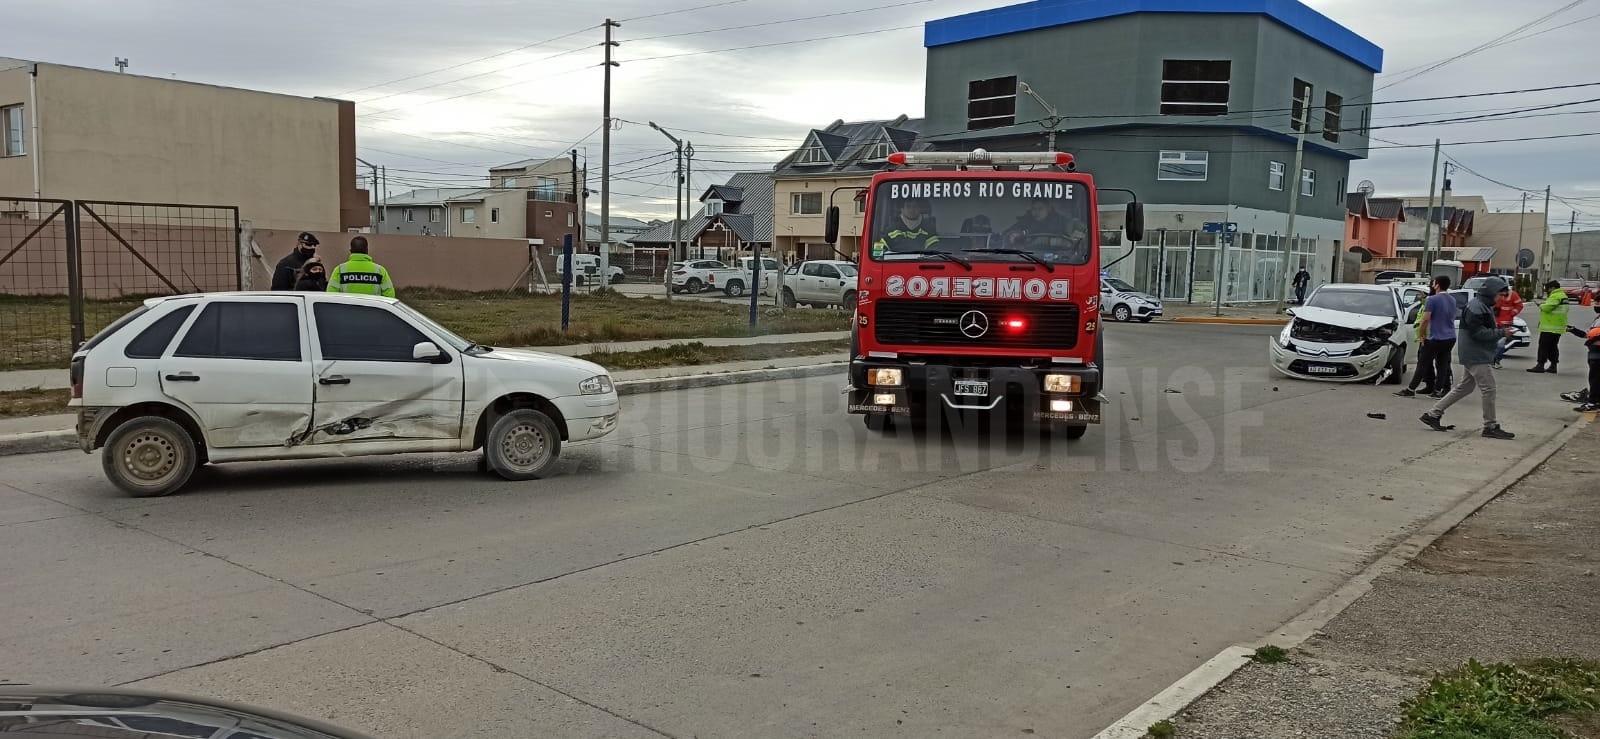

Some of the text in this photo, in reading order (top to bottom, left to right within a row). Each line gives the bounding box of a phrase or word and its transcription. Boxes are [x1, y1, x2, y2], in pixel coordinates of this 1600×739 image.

[891, 182, 1073, 200] BOMBEROS RIO GRANDE
[343, 274, 378, 283] POLICIA
[859, 316, 868, 325] 25
